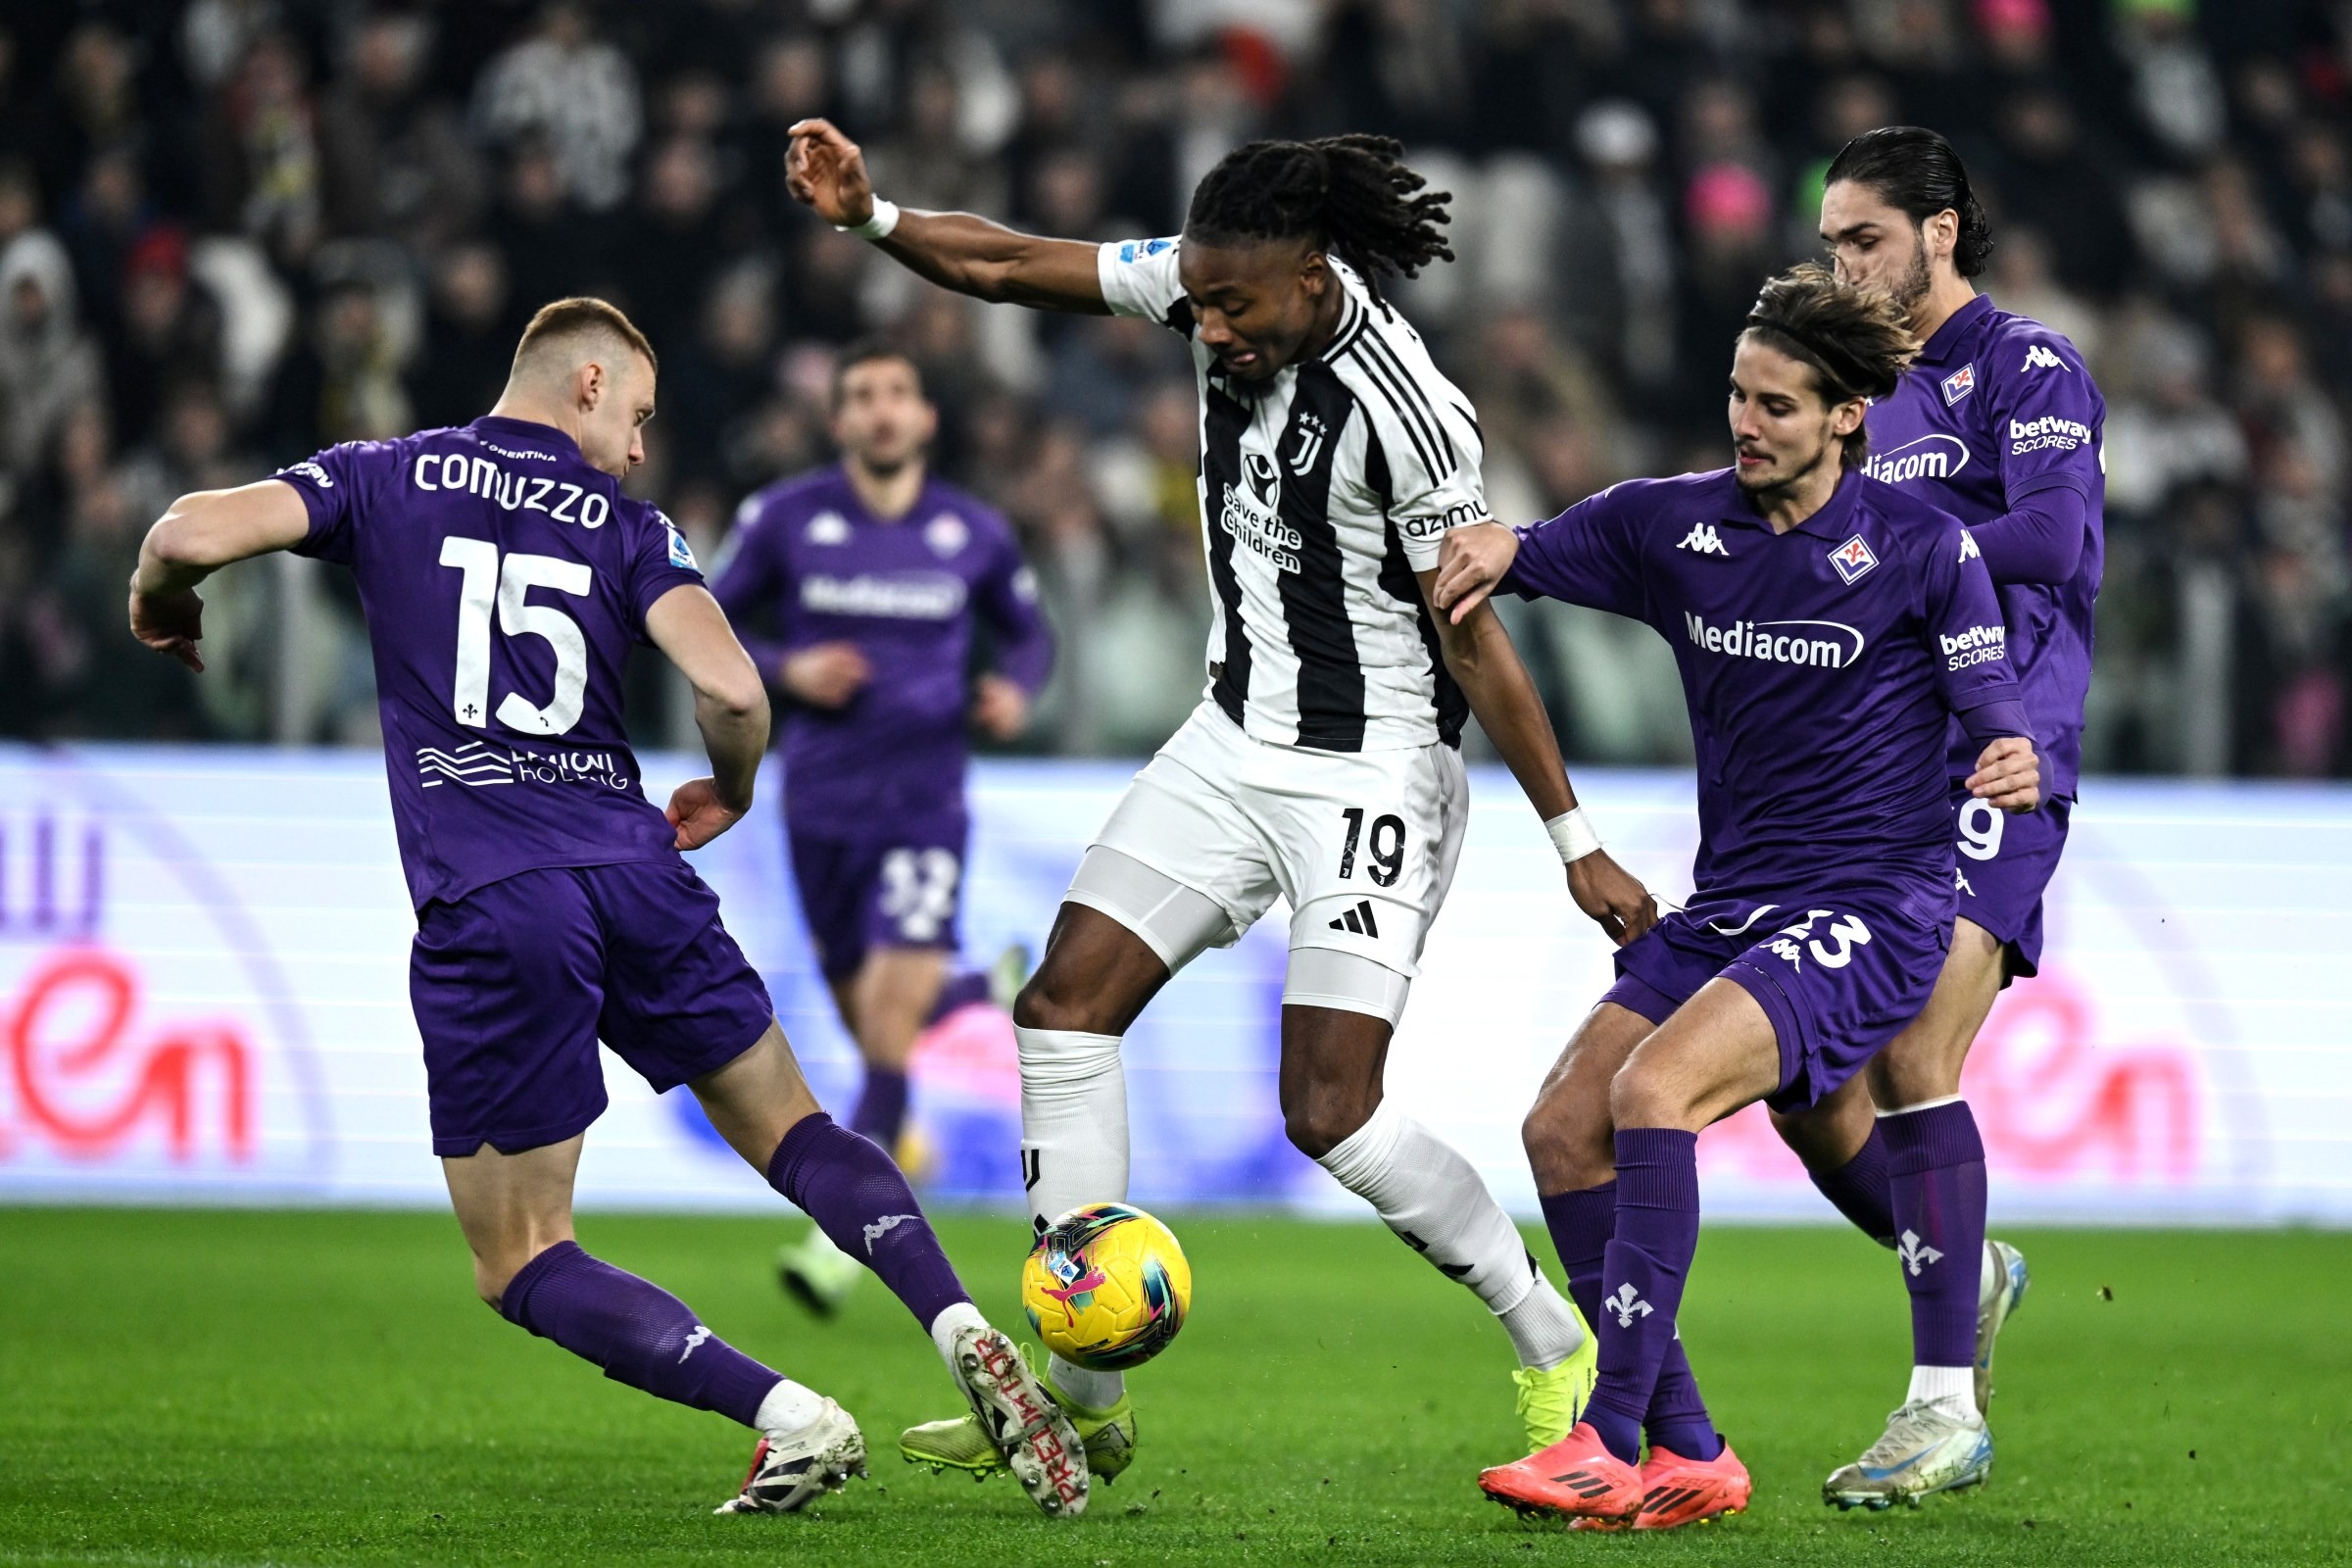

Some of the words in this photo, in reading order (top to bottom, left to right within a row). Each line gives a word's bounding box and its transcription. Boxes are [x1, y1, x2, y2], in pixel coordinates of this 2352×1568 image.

[479, 440, 557, 462] ORENTINA
[2010, 416, 2091, 444] betway
[2011, 435, 2078, 456] SCORES
[415, 454, 610, 529] COMUZZO
[1860, 452, 1948, 484] diacom
[1224, 485, 1259, 528] Save
[1264, 516, 1299, 546] the
[1224, 510, 1298, 570] Children
[439, 536, 592, 736] 15
[1685, 611, 1841, 668] Mediacom
[1948, 645, 2004, 671] SCORES
[1339, 808, 1406, 888] 19
[1951, 798, 2004, 860] 9
